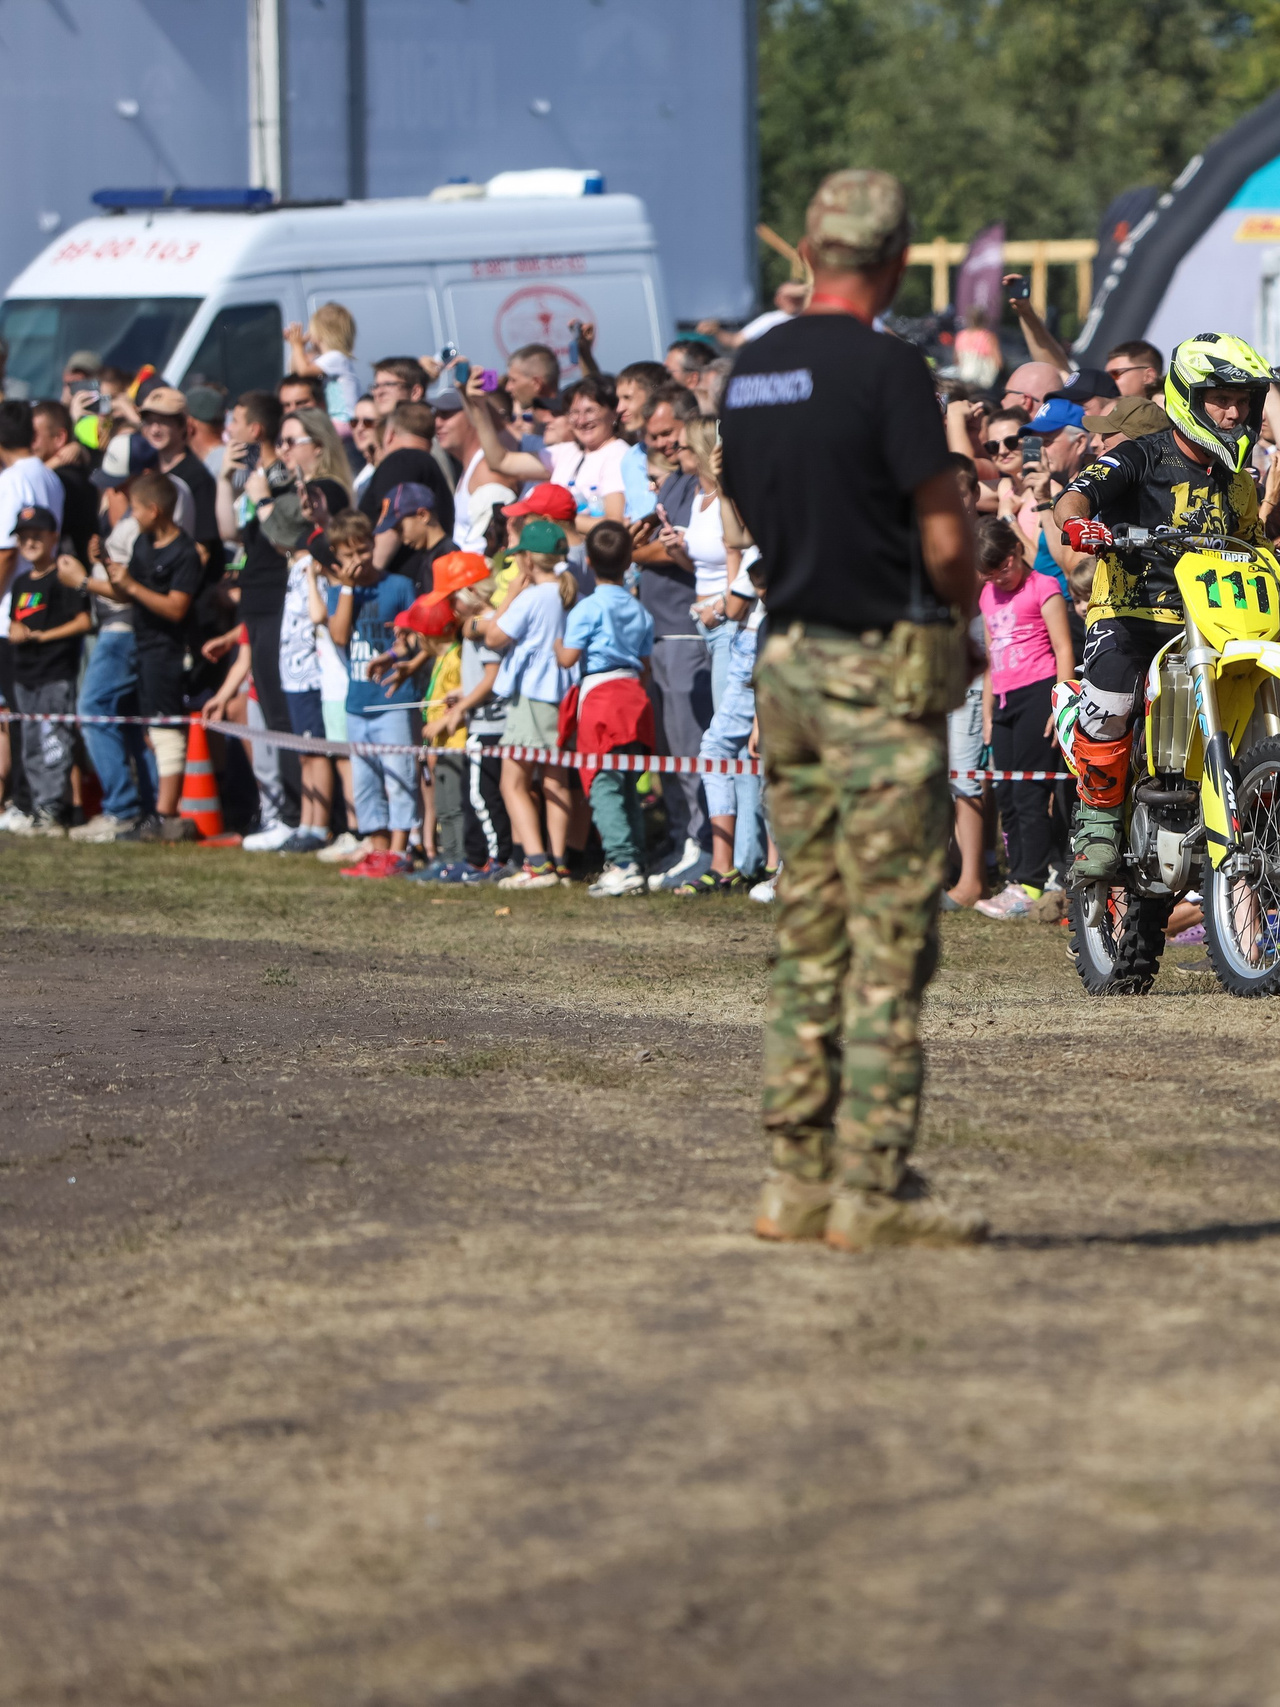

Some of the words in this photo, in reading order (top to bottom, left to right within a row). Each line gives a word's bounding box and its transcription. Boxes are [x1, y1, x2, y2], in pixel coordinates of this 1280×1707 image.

[1195, 569, 1271, 615] 111
[1079, 689, 1117, 725] FOX
[1223, 768, 1240, 832] RM-Z
